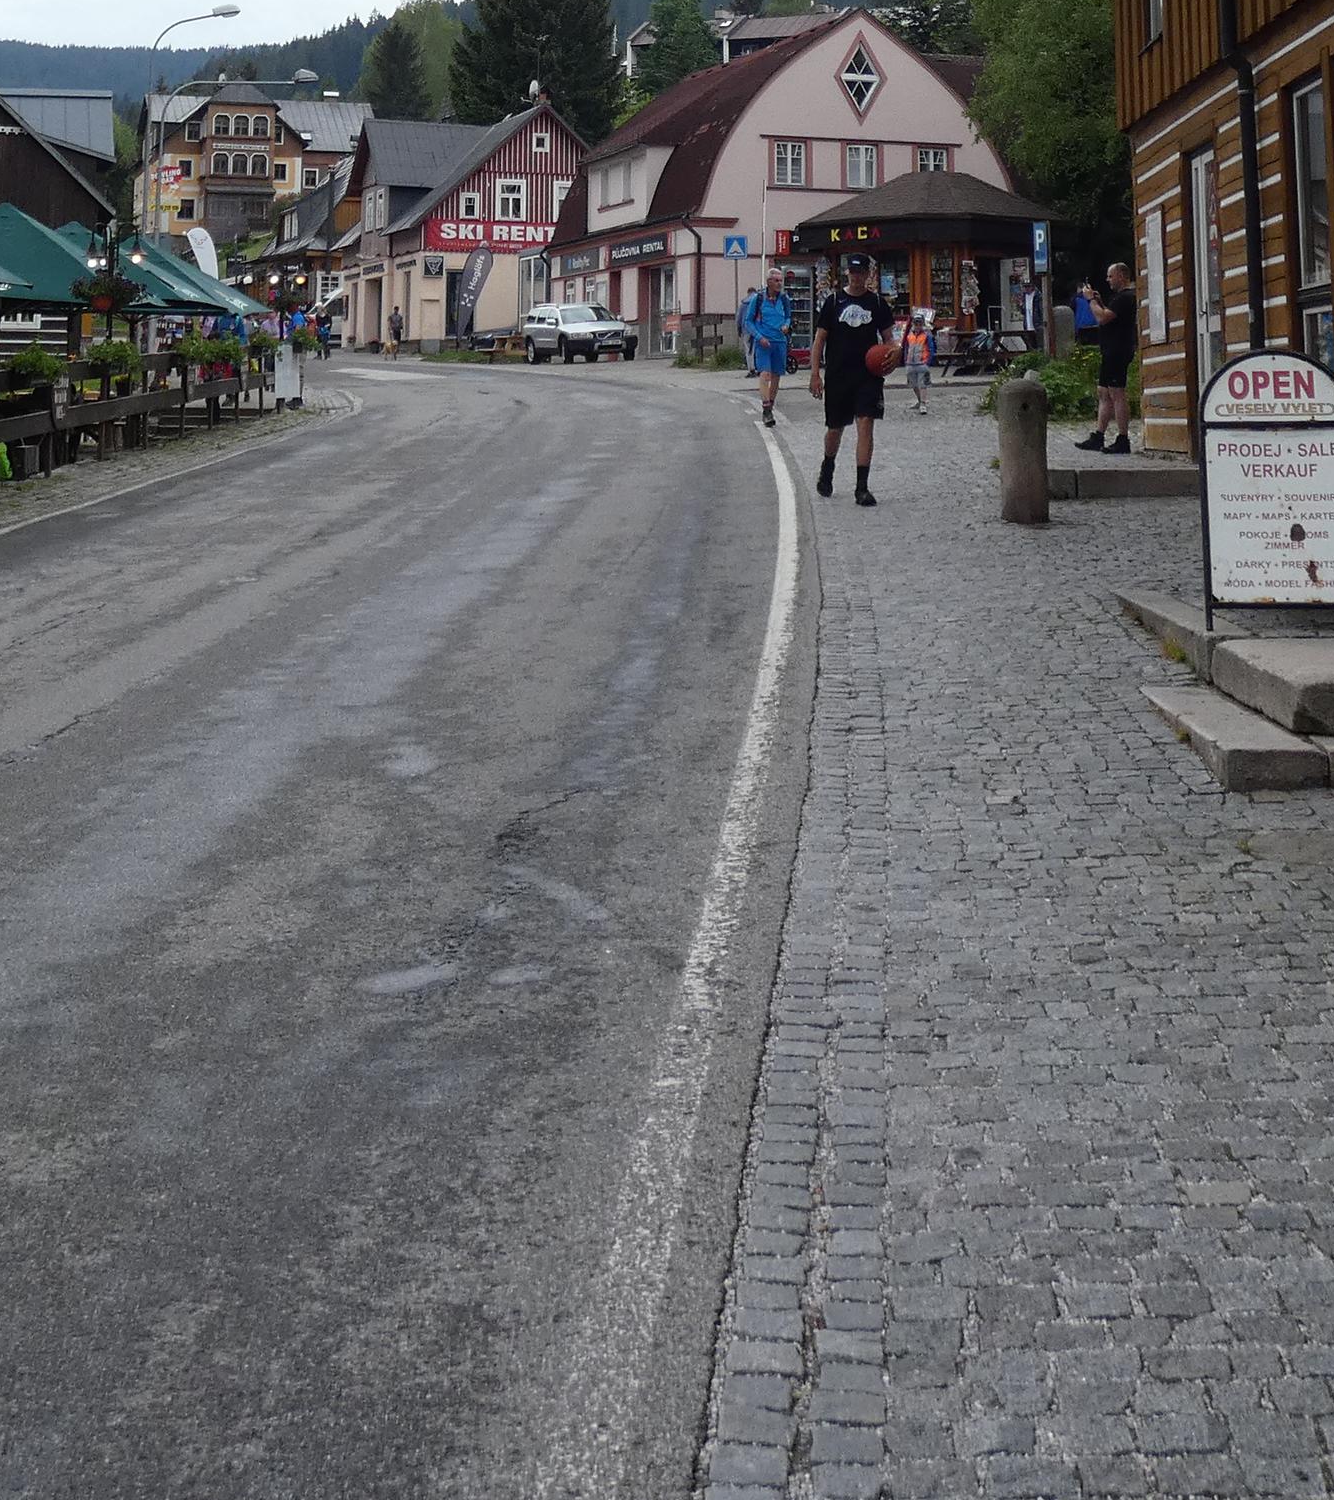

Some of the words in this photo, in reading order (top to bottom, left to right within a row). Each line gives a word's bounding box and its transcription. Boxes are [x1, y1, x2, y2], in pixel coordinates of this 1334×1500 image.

[440, 223, 484, 240] SKI
[492, 225, 555, 242] RENT
[1035, 229, 1044, 250] P
[642, 241, 664, 254] RENTAL
[467, 254, 485, 291] Haglöfs
[1228, 370, 1315, 400] OPEN
[1217, 443, 1281, 457] PRODEJ
[1240, 463, 1318, 478] VERKAUF
[1223, 512, 1252, 520] MAPY
[1261, 512, 1291, 520] MAPS
[1238, 531, 1281, 540] POKOJE
[1264, 542, 1305, 550] ZIMMER
[1264, 579, 1302, 588] MODEL
